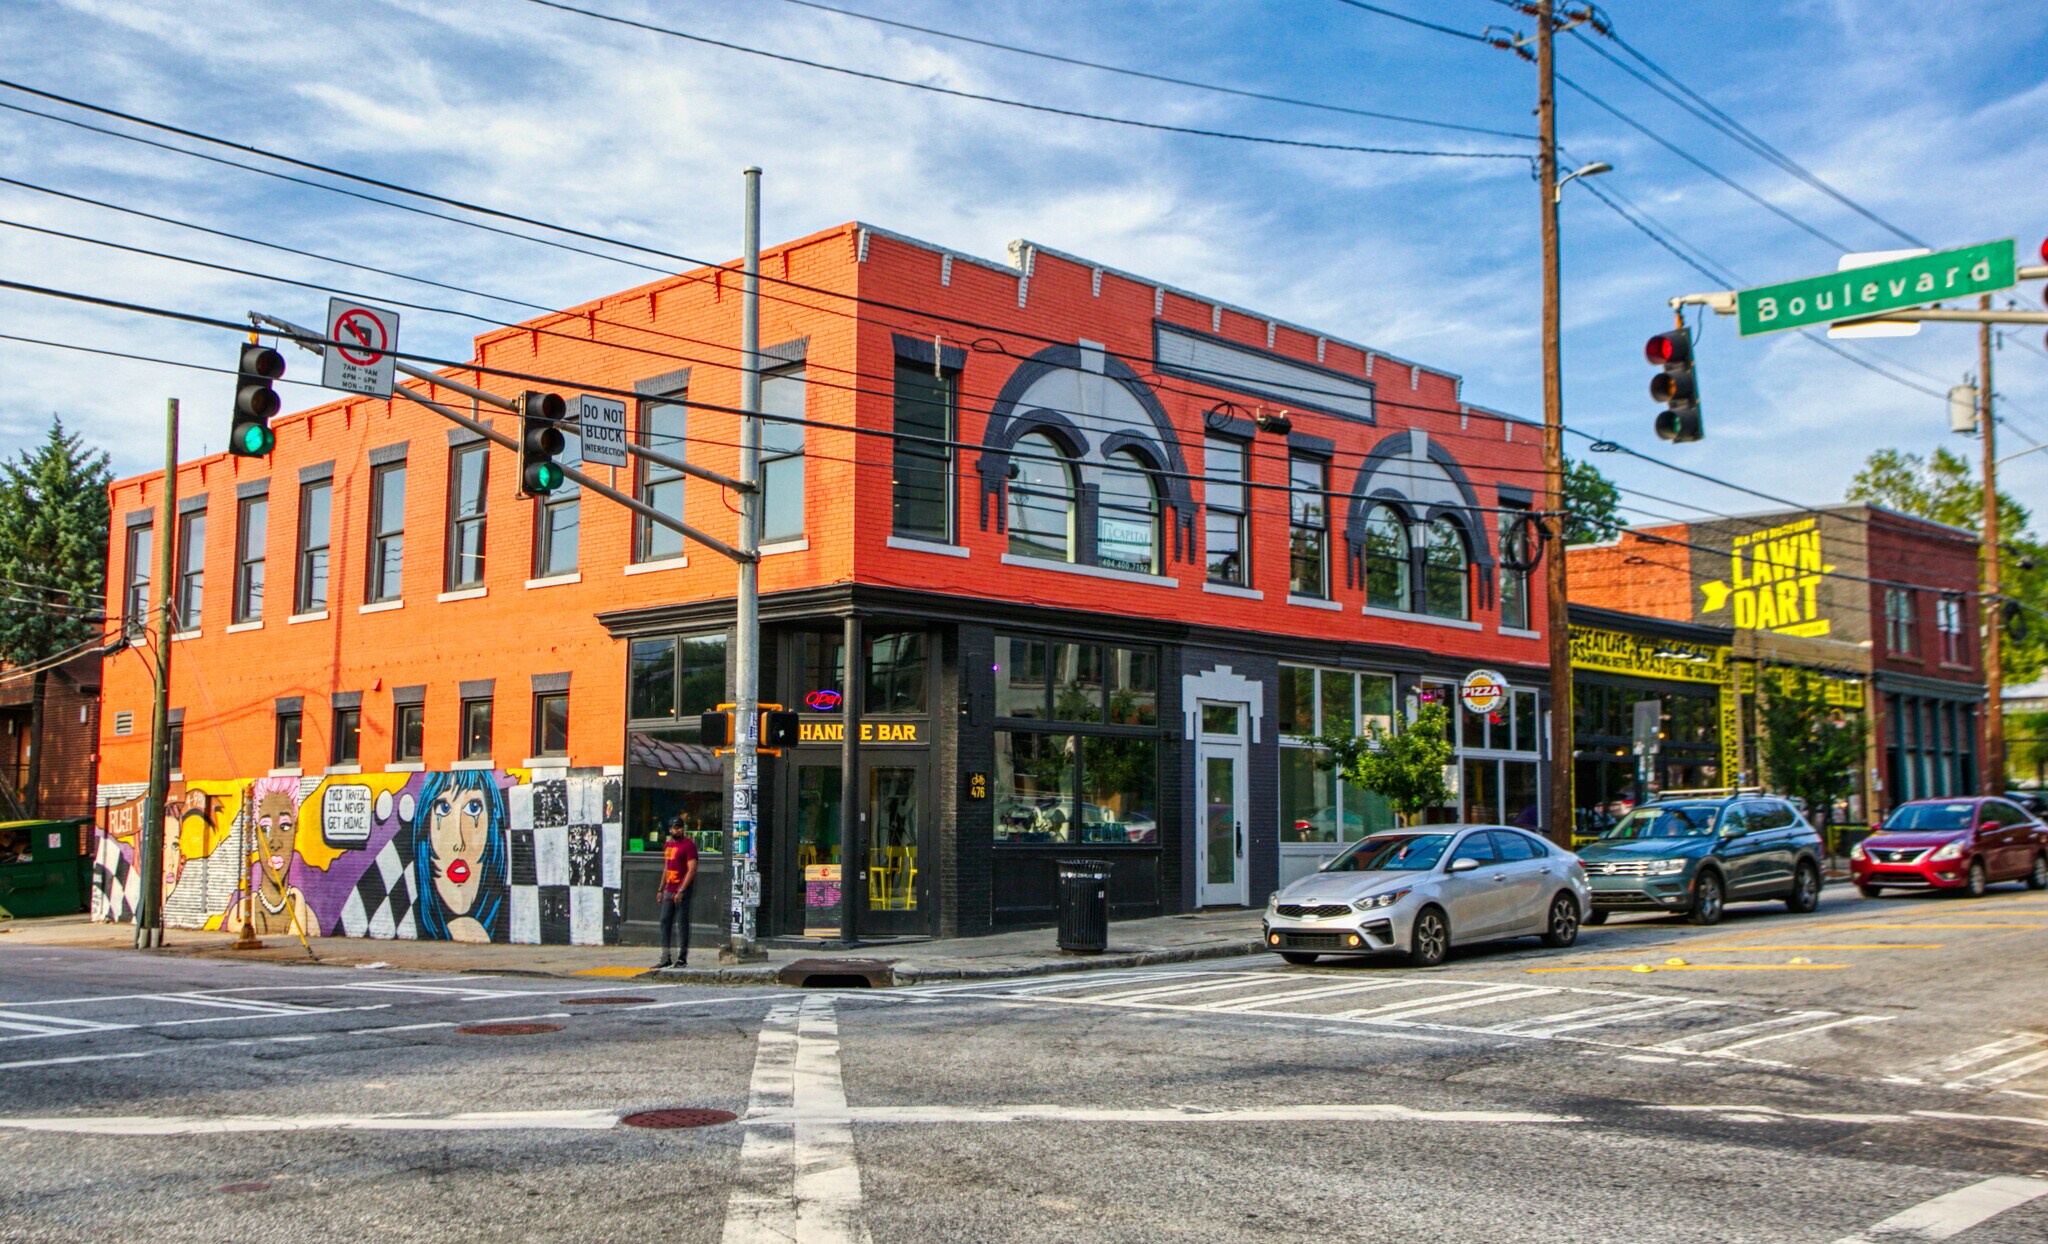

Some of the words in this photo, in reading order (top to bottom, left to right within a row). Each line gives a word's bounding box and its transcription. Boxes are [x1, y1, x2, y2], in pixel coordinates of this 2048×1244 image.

[1757, 256, 1990, 323] Boulevard
[343, 363, 357, 372] 7AM
[363, 368, 378, 377] 9AM
[342, 373, 357, 381] 4PM
[363, 377, 377, 385] 6PM
[342, 381, 357, 390] MON
[583, 403, 599, 420] DO
[603, 407, 624, 425] NOT
[586, 425, 623, 443] BLOCK
[584, 443, 625, 458] INTERSECTION
[1731, 529, 1822, 590] LAWN
[1733, 574, 1822, 631] DART
[805, 691, 843, 706] Open
[1462, 686, 1501, 698] PIZZA
[800, 723, 873, 741] HANE
[877, 724, 917, 741] BAR
[328, 788, 343, 801] THIS
[971, 786, 985, 799] 476
[344, 802, 366, 814] NEVER
[108, 806, 133, 834] RUSH
[327, 816, 341, 830] GET
